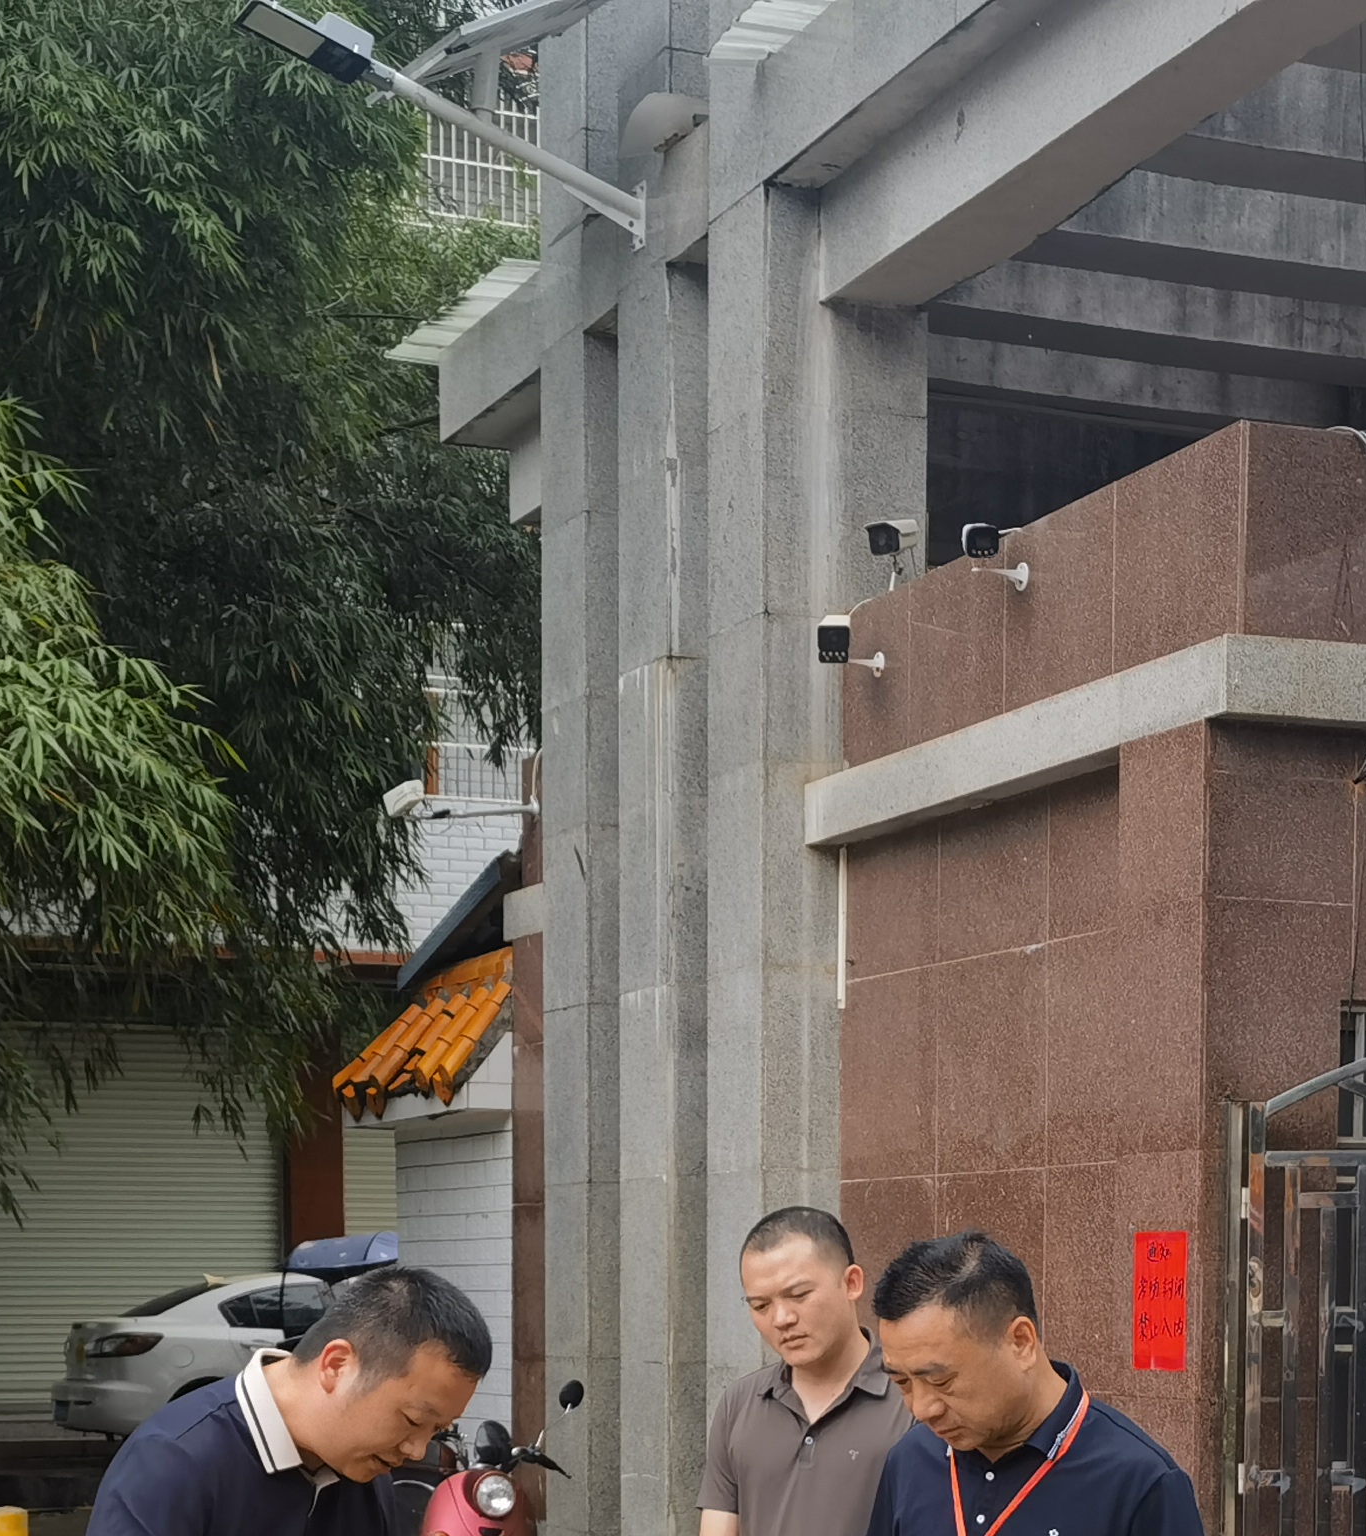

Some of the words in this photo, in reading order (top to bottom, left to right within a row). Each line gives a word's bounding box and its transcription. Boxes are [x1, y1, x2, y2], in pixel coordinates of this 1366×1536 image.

[1146, 1241, 1172, 1263] 通知
[1138, 1311, 1185, 1342] 禁止入内
